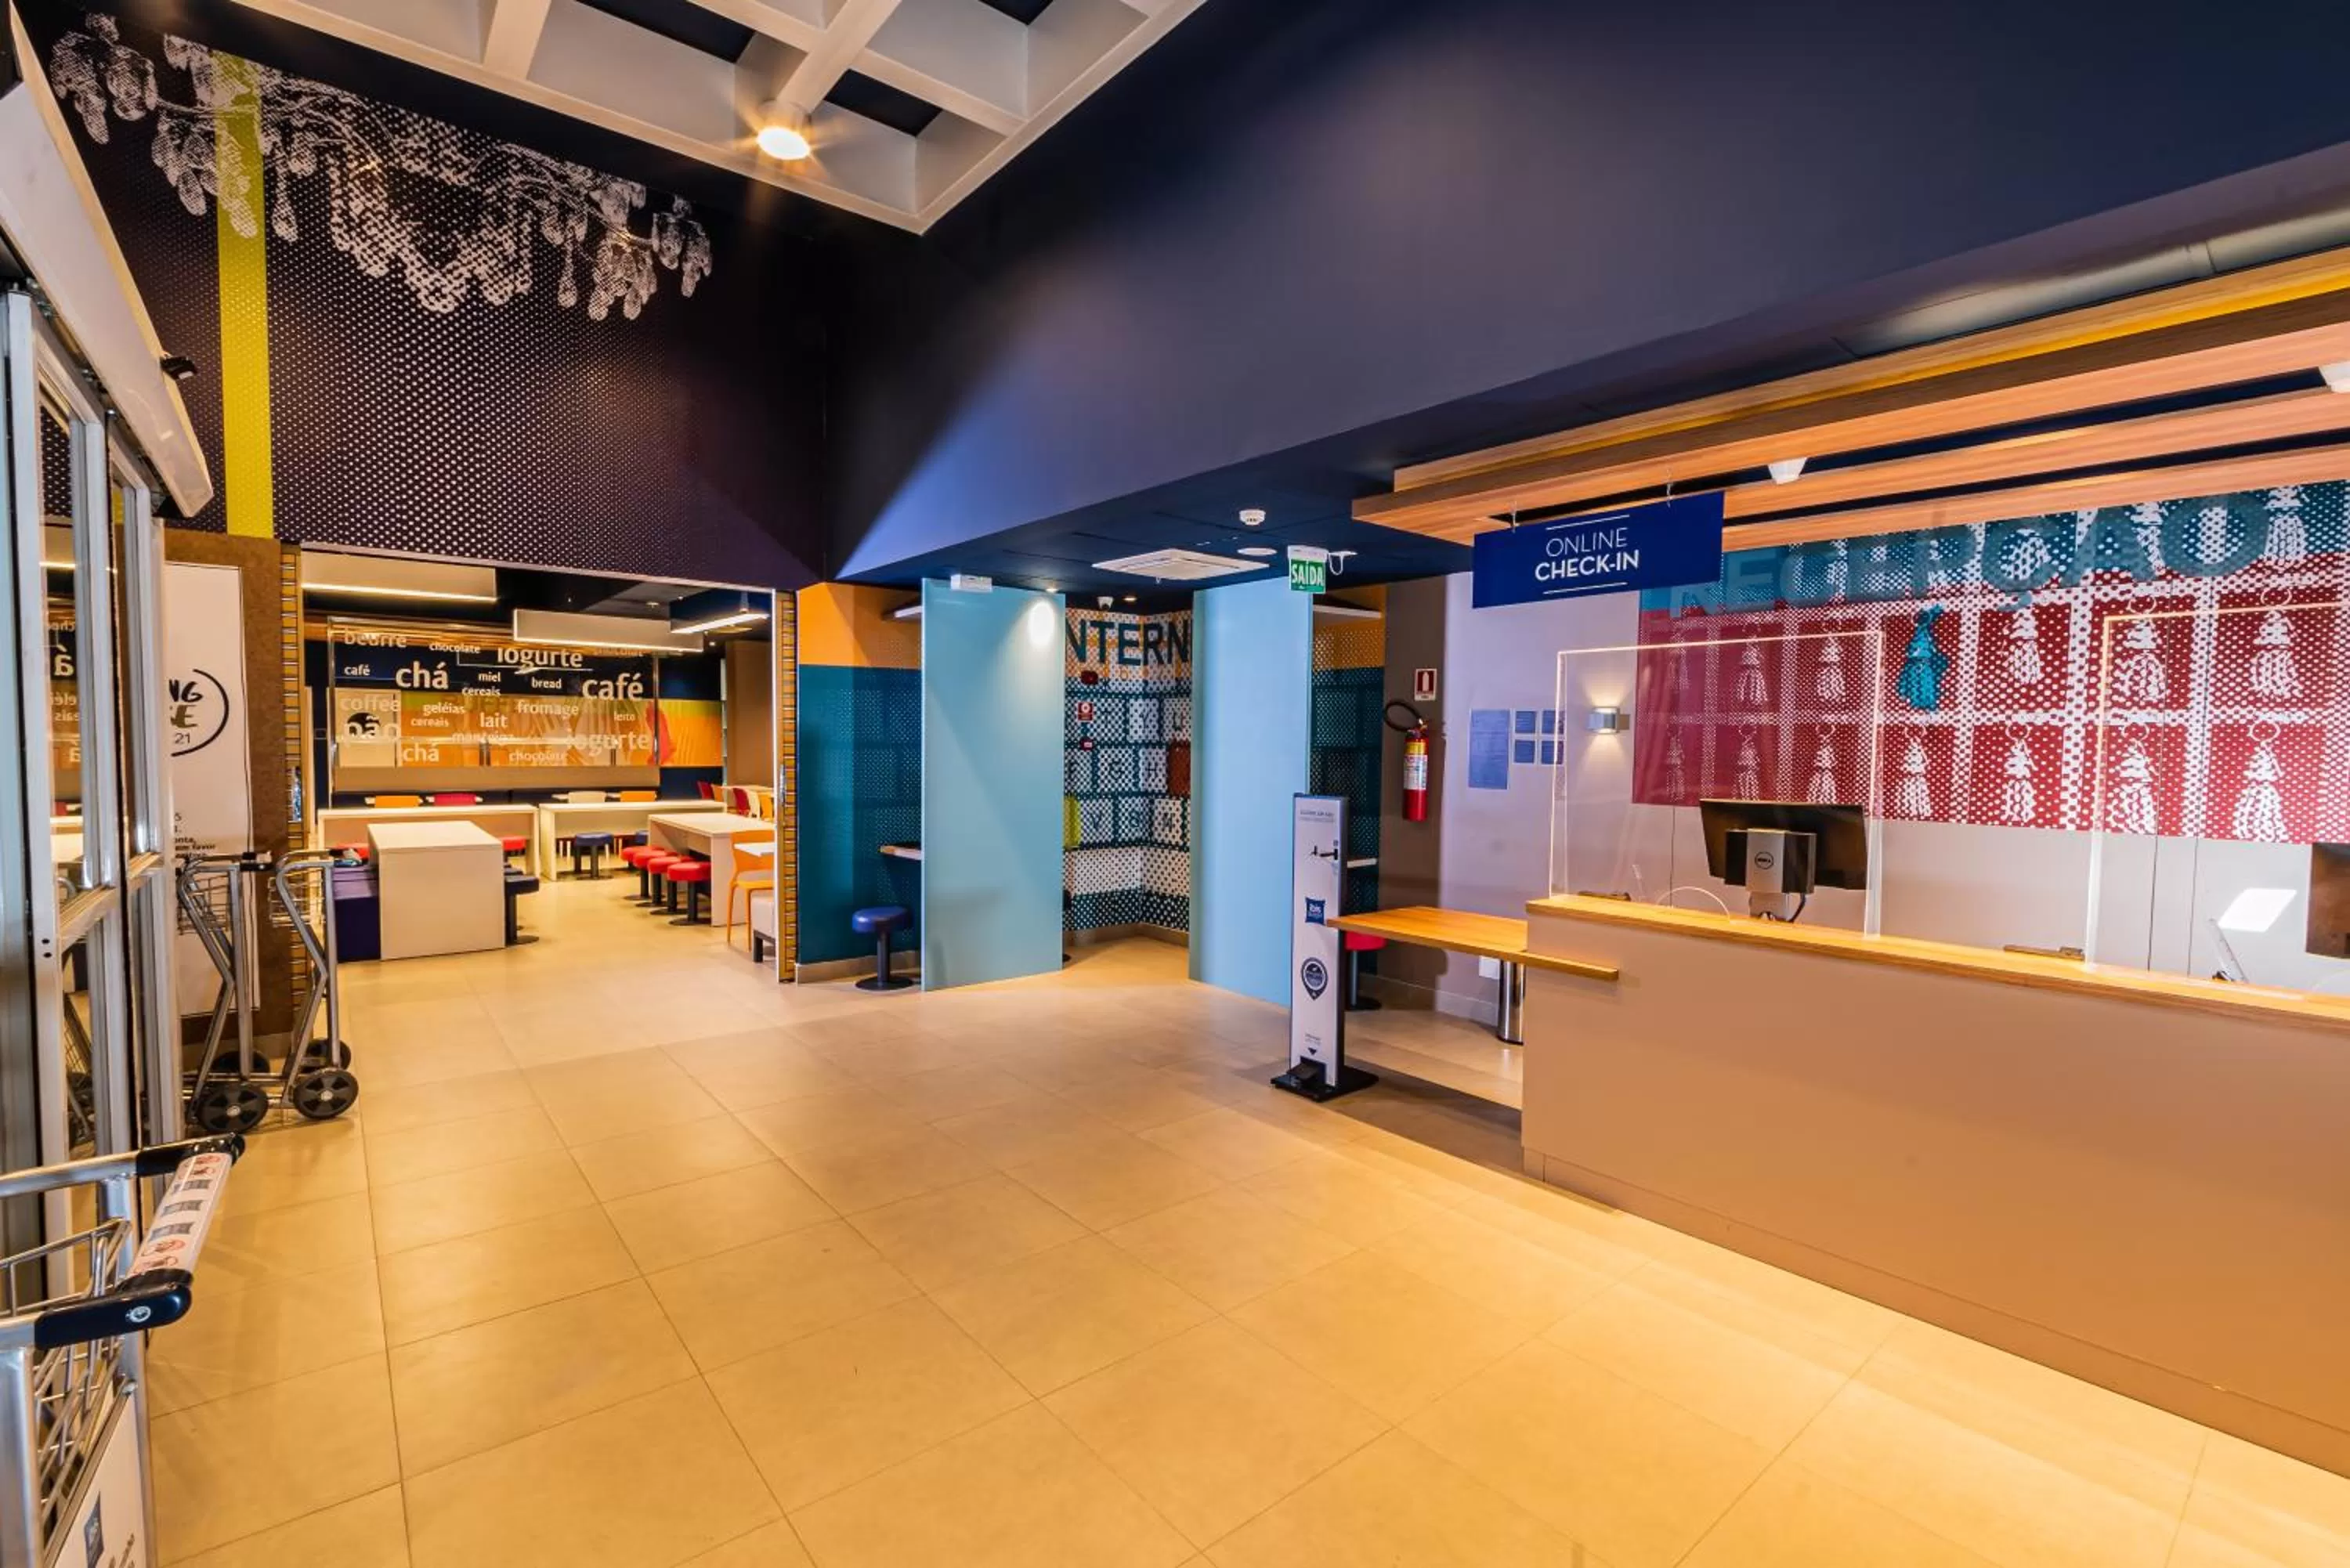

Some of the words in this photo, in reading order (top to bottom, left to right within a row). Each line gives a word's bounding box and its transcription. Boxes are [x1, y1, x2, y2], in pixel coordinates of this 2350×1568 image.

[1546, 527, 1628, 558] ONLINE
[1535, 549, 1640, 581] CHECK-IN
[344, 664, 371, 676] café
[396, 660, 449, 690] chá
[479, 671, 501, 683] miel
[462, 686, 501, 697] cereais
[531, 677, 562, 689] bread
[582, 672, 643, 701] café
[518, 699, 579, 720] fromage
[480, 712, 508, 728] lait
[403, 742, 439, 762] chá
